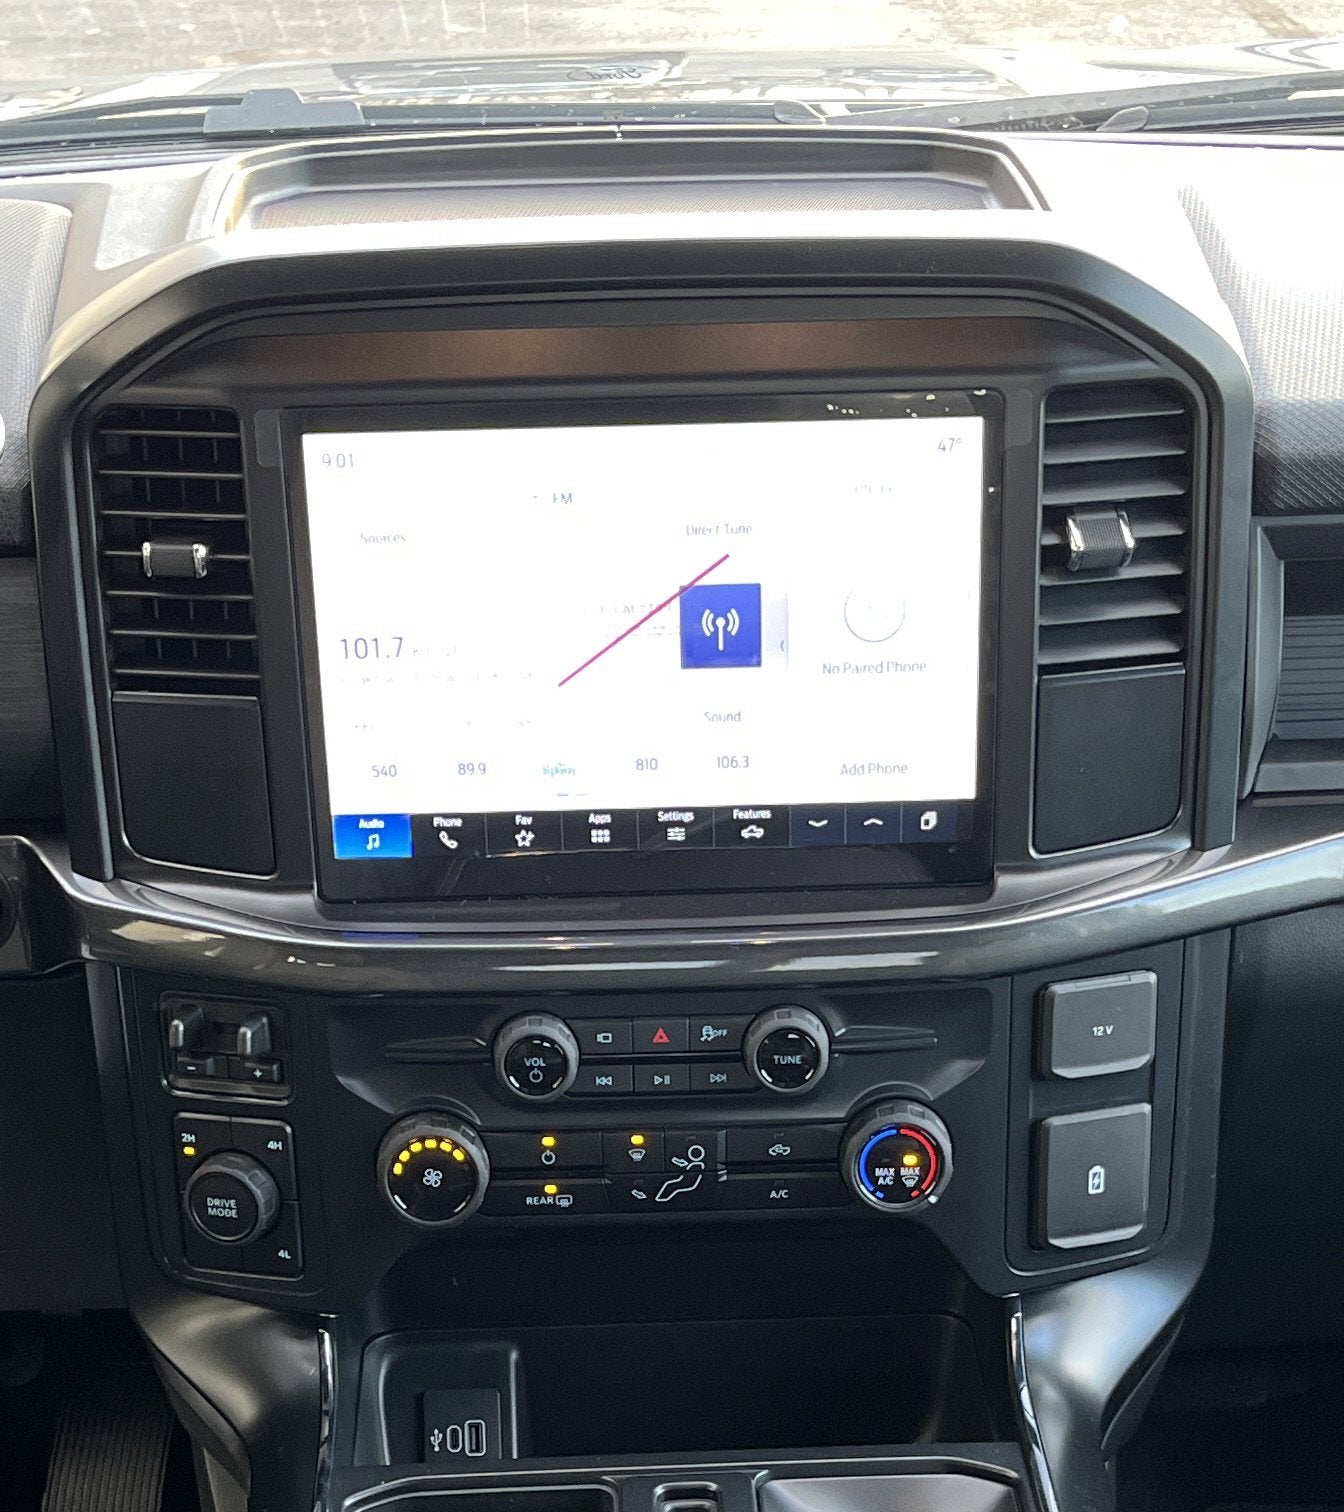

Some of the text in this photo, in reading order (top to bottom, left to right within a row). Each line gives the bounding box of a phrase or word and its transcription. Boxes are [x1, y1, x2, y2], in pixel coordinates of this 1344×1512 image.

[340, 636, 404, 659] 101.7
[822, 662, 840, 675] No
[886, 660, 927, 674] Phone
[704, 711, 742, 723] Sound
[635, 757, 658, 771] 810
[716, 755, 750, 769] 106.3
[371, 764, 397, 778] 540
[839, 762, 909, 776] Add Phone
[515, 814, 533, 826] Fav
[588, 812, 612, 825] Apps
[657, 810, 695, 823] Settings
[732, 808, 772, 820] Features
[359, 818, 385, 829] Audio
[433, 816, 463, 828] Phone
[712, 1029, 728, 1038] OFF
[1092, 1024, 1114, 1037] 12 V
[523, 1057, 547, 1068] VOL
[773, 1054, 803, 1066] TUNE
[181, 1132, 196, 1144] 2H
[267, 1139, 283, 1151] 4H
[874, 1167, 895, 1177] MAX
[900, 1166, 921, 1176] MAX
[877, 1176, 894, 1186] A/C
[769, 1188, 789, 1199] A/C
[206, 1197, 237, 1209] DRIVE
[525, 1195, 554, 1206] REAR
[207, 1206, 239, 1219] MODE
[277, 1248, 292, 1260] 4L
